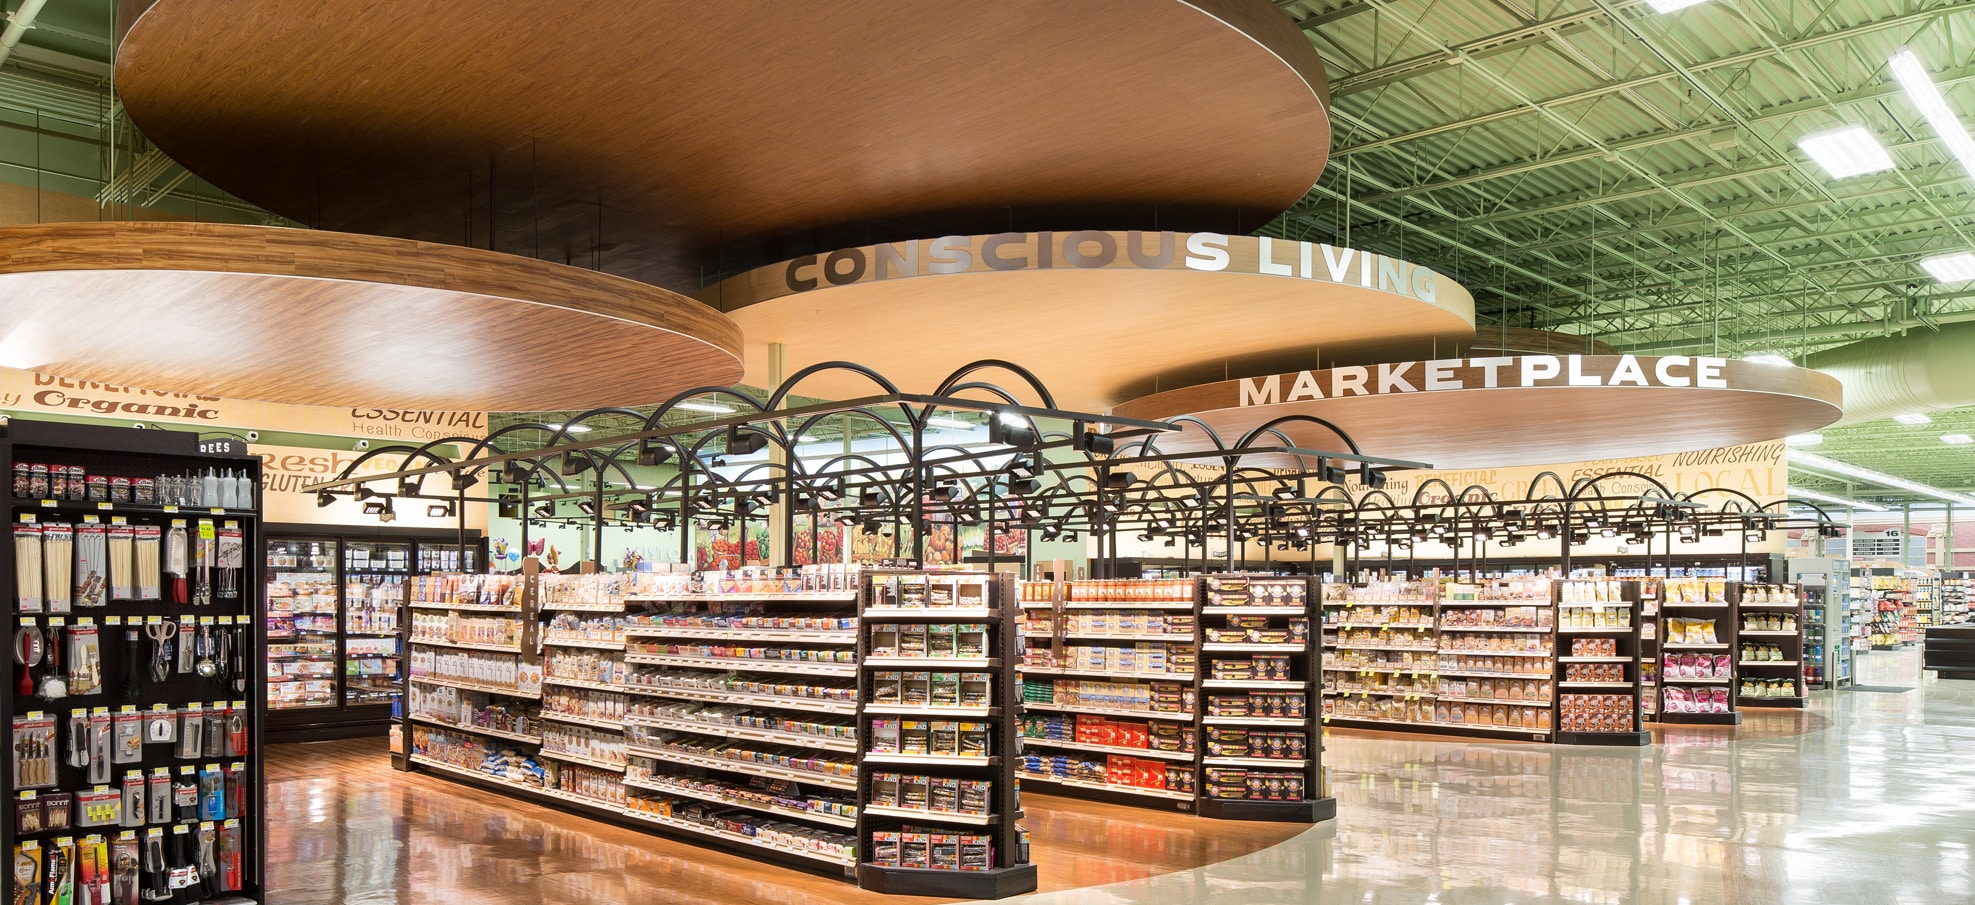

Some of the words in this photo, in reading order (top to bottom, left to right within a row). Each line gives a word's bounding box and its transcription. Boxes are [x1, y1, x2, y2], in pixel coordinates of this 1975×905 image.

[785, 230, 1231, 293] CONSCIOUS
[1257, 236, 1438, 303] LIVING
[1238, 354, 1727, 407] MARKETPLACE
[33, 389, 219, 420] Organic
[351, 421, 402, 437] Health
[1672, 442, 1786, 468] NOURISHING
[1571, 463, 1664, 482] ESSENTIAL
[1674, 467, 1785, 498] LOCAL
